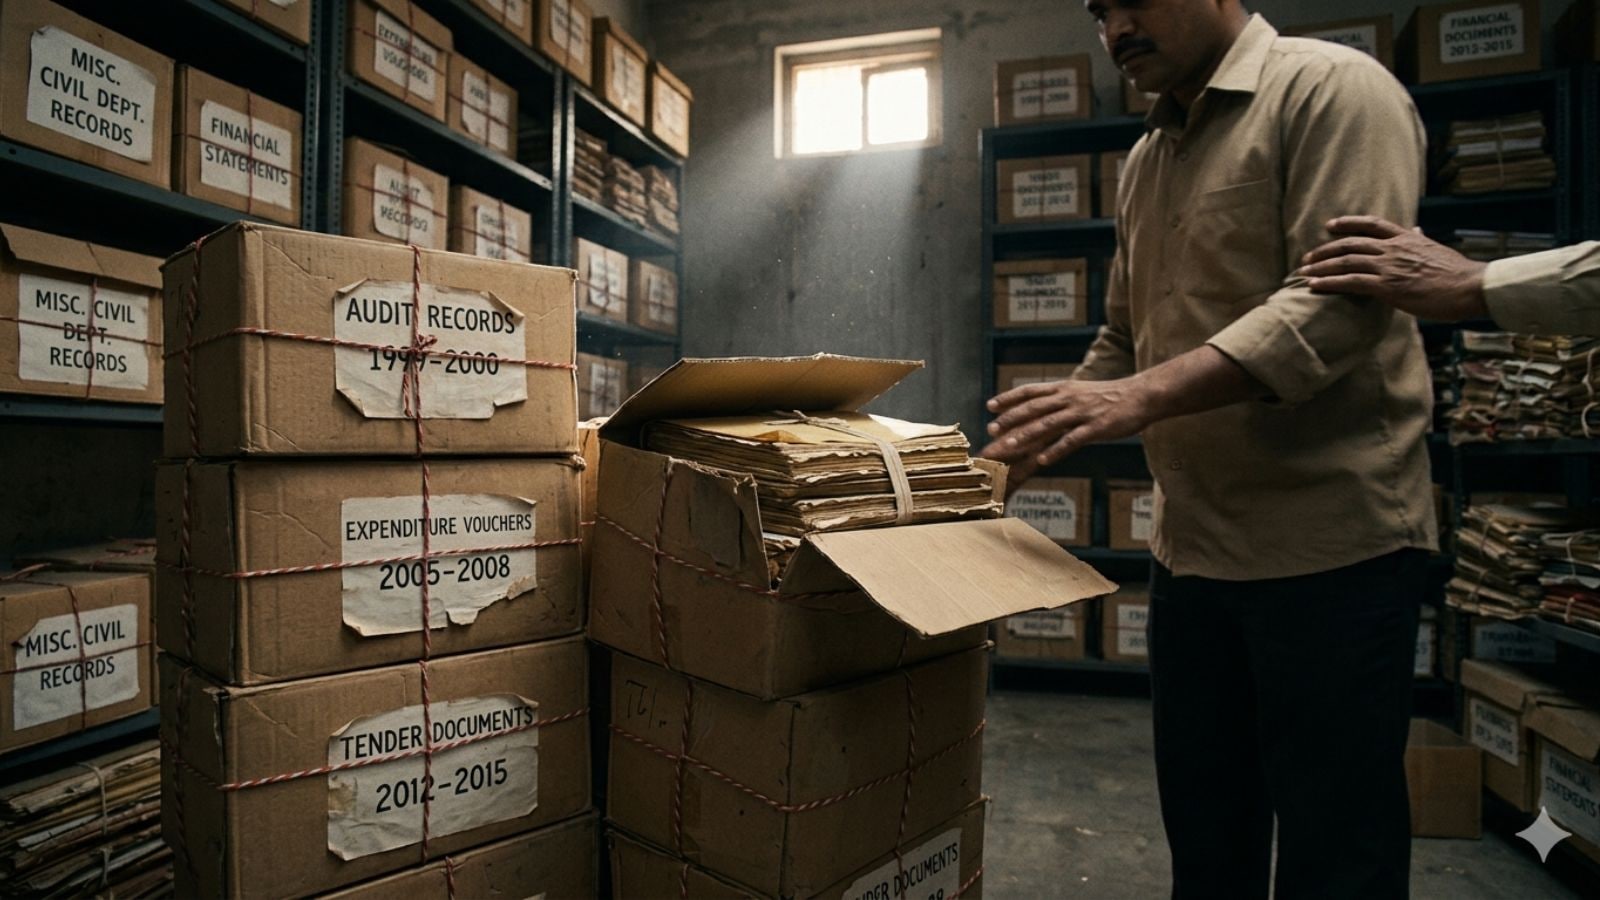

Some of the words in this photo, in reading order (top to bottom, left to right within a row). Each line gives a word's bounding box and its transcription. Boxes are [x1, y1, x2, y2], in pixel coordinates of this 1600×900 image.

[1444, 24, 1517, 44] DOCUMENTS
[1450, 11, 1512, 29] FINANCIAL
[71, 47, 121, 86] MISC.
[40, 66, 89, 102] CIVIL
[97, 87, 145, 123] DEPT.
[51, 99, 133, 146] RECORDS
[211, 117, 281, 156] FINANCIAL
[205, 144, 289, 185] STATEMENTS
[36, 289, 86, 316] MISC.
[94, 300, 135, 324] CIVIL
[346, 297, 414, 326] AUDIT
[428, 304, 515, 334] RECORDS
[63, 321, 111, 346] DEPT.
[50, 346, 127, 373] RECORDS
[346, 516, 458, 541] EXPENDITURE
[463, 513, 532, 533] VOUCHERS
[379, 554, 511, 590] 2005-2008
[25, 629, 77, 658] MISC.
[83, 619, 126, 646] CIVIL
[40, 655, 116, 691] RECORDS
[340, 724, 423, 761] TENDER
[432, 705, 534, 743] DOCUMENTS
[375, 757, 508, 814] 2012-2015
[893, 842, 959, 897] DOCUMENTS
